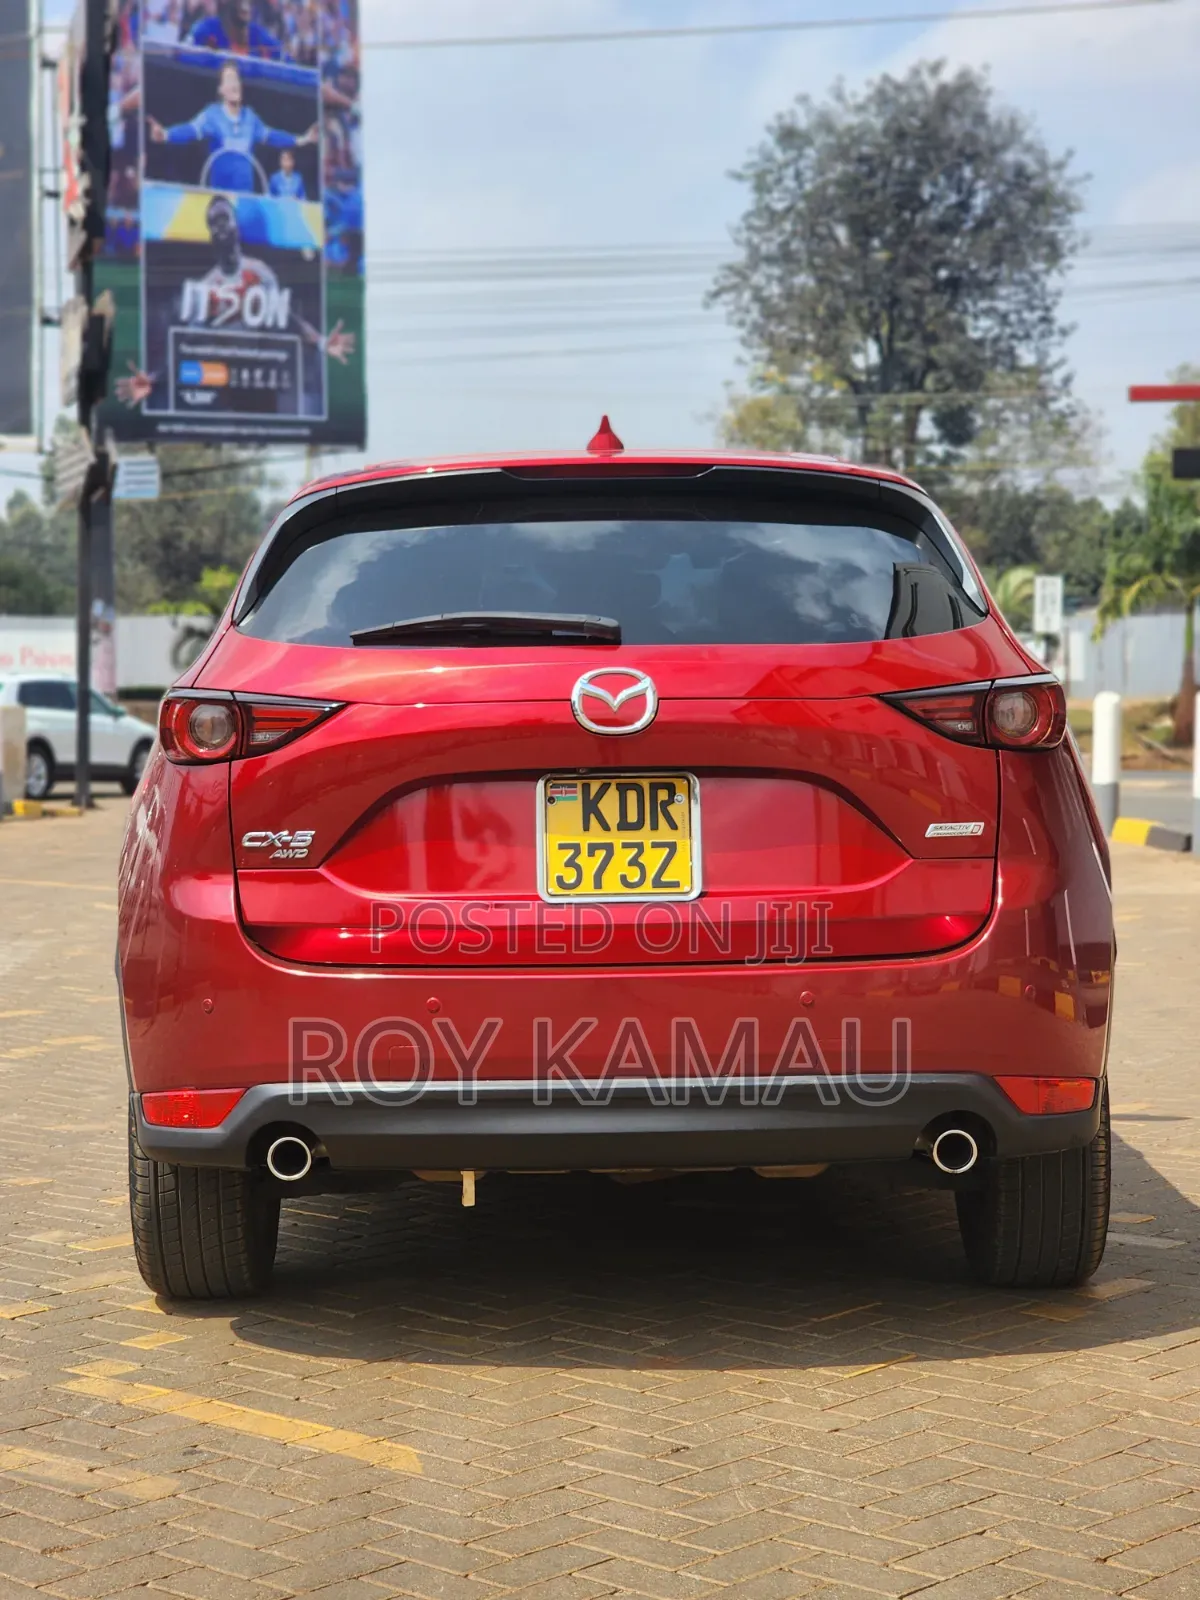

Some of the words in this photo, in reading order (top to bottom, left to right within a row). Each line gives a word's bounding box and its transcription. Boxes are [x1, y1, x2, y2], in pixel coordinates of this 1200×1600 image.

[581, 782, 679, 832] KDR
[241, 829, 316, 848] CX-5
[268, 848, 309, 859] AWD
[555, 840, 681, 891] 373Z
